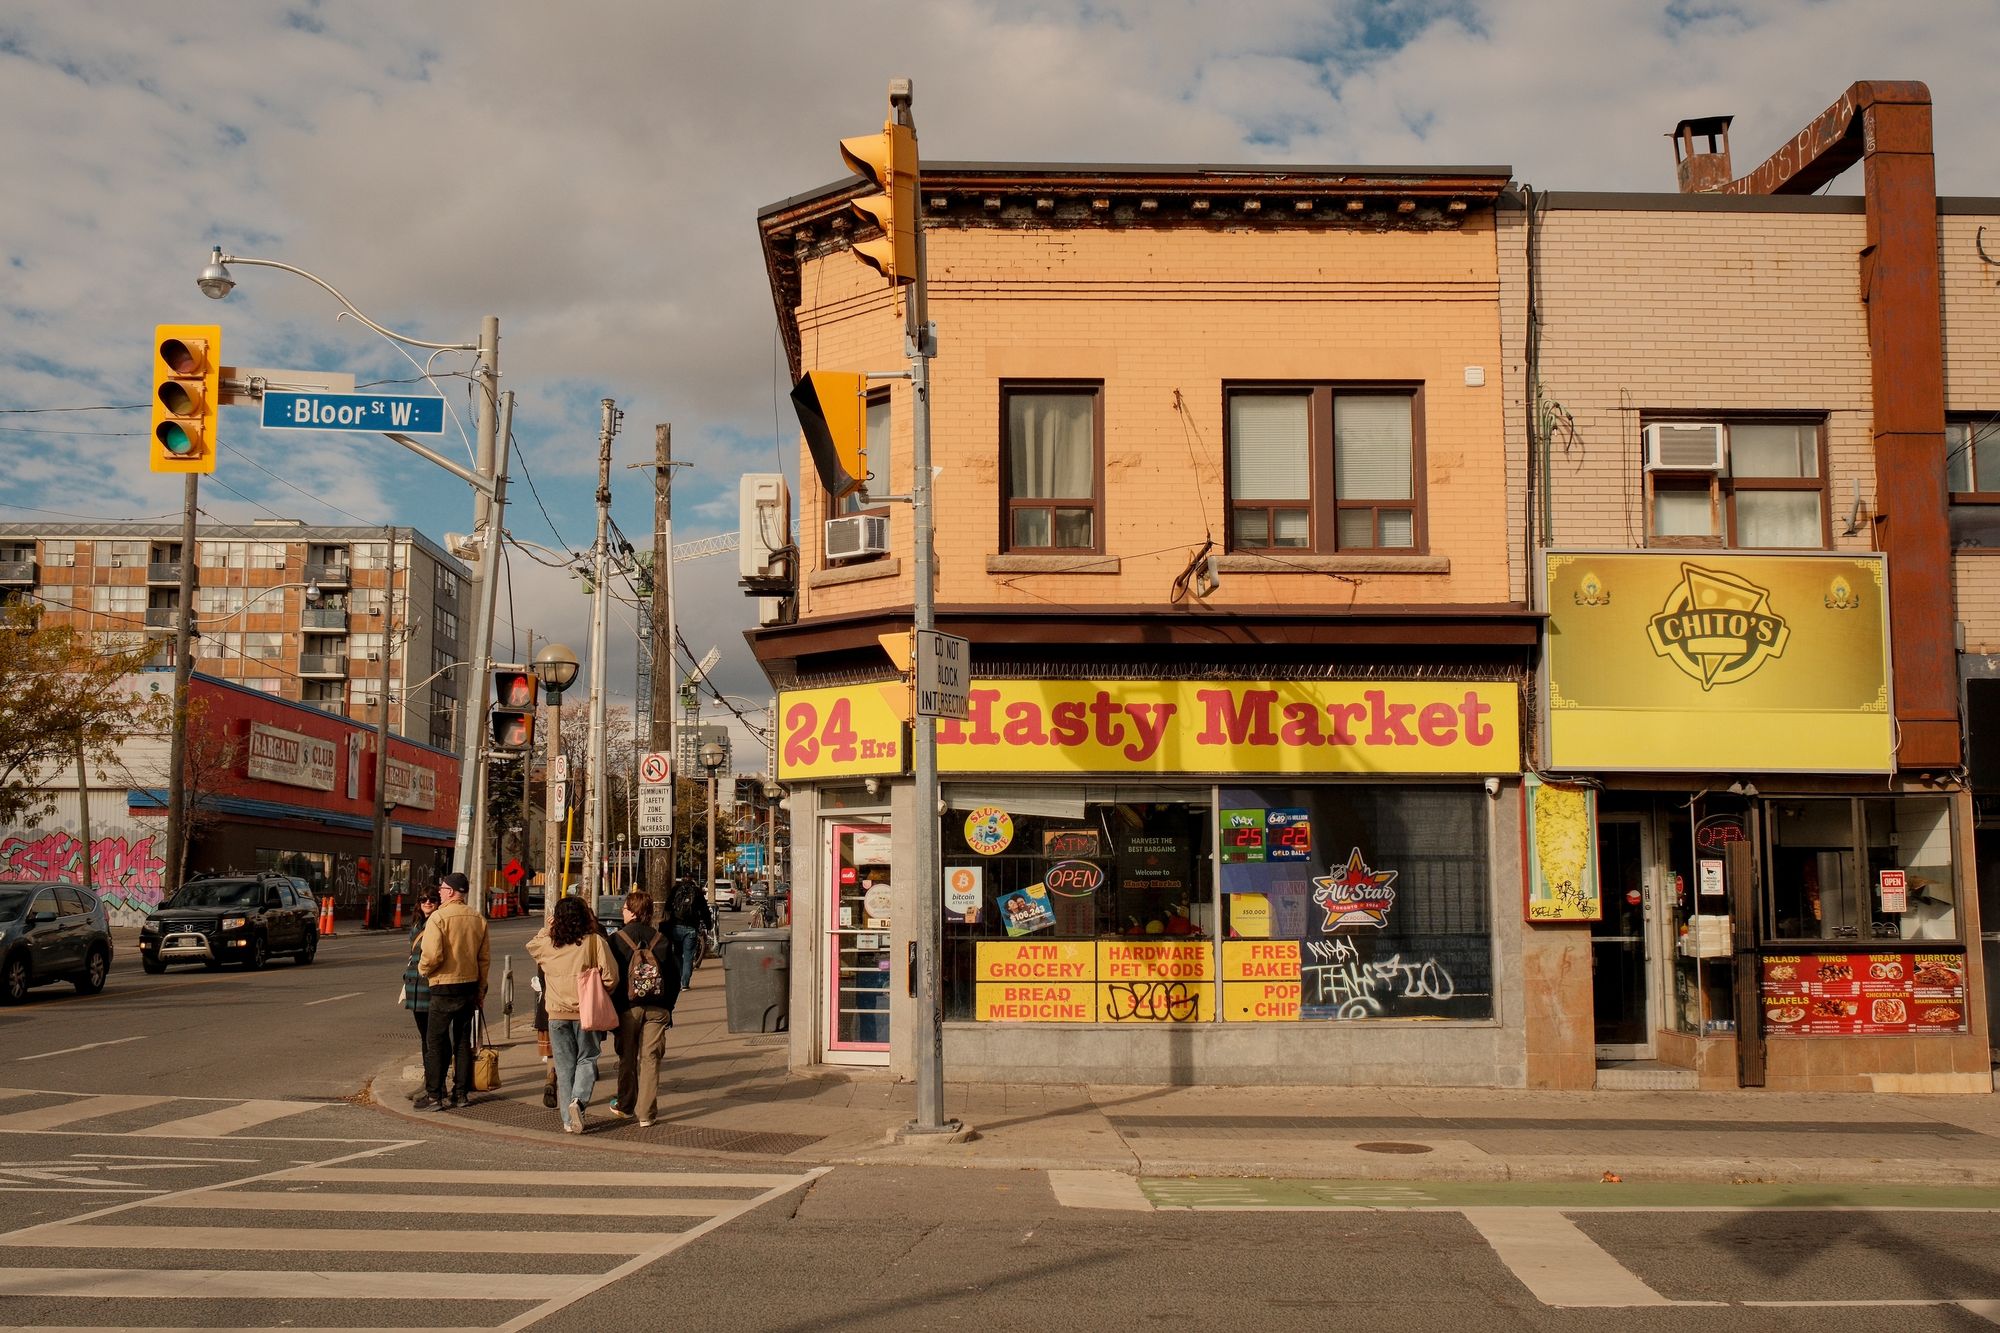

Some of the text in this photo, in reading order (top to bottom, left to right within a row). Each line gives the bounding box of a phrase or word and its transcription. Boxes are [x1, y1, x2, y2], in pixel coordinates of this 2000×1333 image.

[294, 398, 412, 426] Bloor St W
[1663, 614, 1773, 642] CHITO'S
[934, 637, 960, 661] DO NOT
[938, 664, 959, 687] BLOCK
[784, 697, 896, 767] 24 Hrs
[937, 688, 1495, 762] Hasty Market
[254, 733, 298, 764] BARGAIN
[312, 745, 334, 767] CLUB
[385, 764, 410, 788] ARGAIN
[419, 774, 434, 792] CLUB
[647, 805, 661, 813] ZONE
[1230, 815, 1254, 827] MAX
[643, 838, 666, 847] ENDS
[1131, 837, 1159, 845] HARVEST
[1236, 827, 1262, 847] 25
[1281, 827, 1307, 846] 22
[1697, 827, 1745, 847] OPEN
[968, 836, 1010, 853] PUPPIE
[1054, 837, 1089, 851] ATM
[1050, 869, 1099, 888] OPEN
[1123, 879, 1182, 889] Hasty Market
[1884, 877, 1902, 886] OPEN
[1316, 882, 1394, 901] All Star
[1016, 945, 1058, 960] ATM
[1109, 946, 1205, 960] HARDWARE
[1251, 945, 1298, 959] FRES
[1817, 955, 1848, 963] WINGS
[1869, 954, 1902, 962] WRAPS
[1914, 953, 1962, 962] BURRITOS
[1762, 955, 1801, 964] SALADS
[989, 963, 1085, 977] GROCERY
[1110, 963, 1204, 977] PET FOODS
[1004, 987, 1071, 1001] BREAD
[1264, 985, 1300, 999] POP
[1762, 996, 1810, 1005] FALAFELS
[989, 1004, 1086, 1018] MEDICINE
[1254, 1002, 1298, 1017] CHIP
